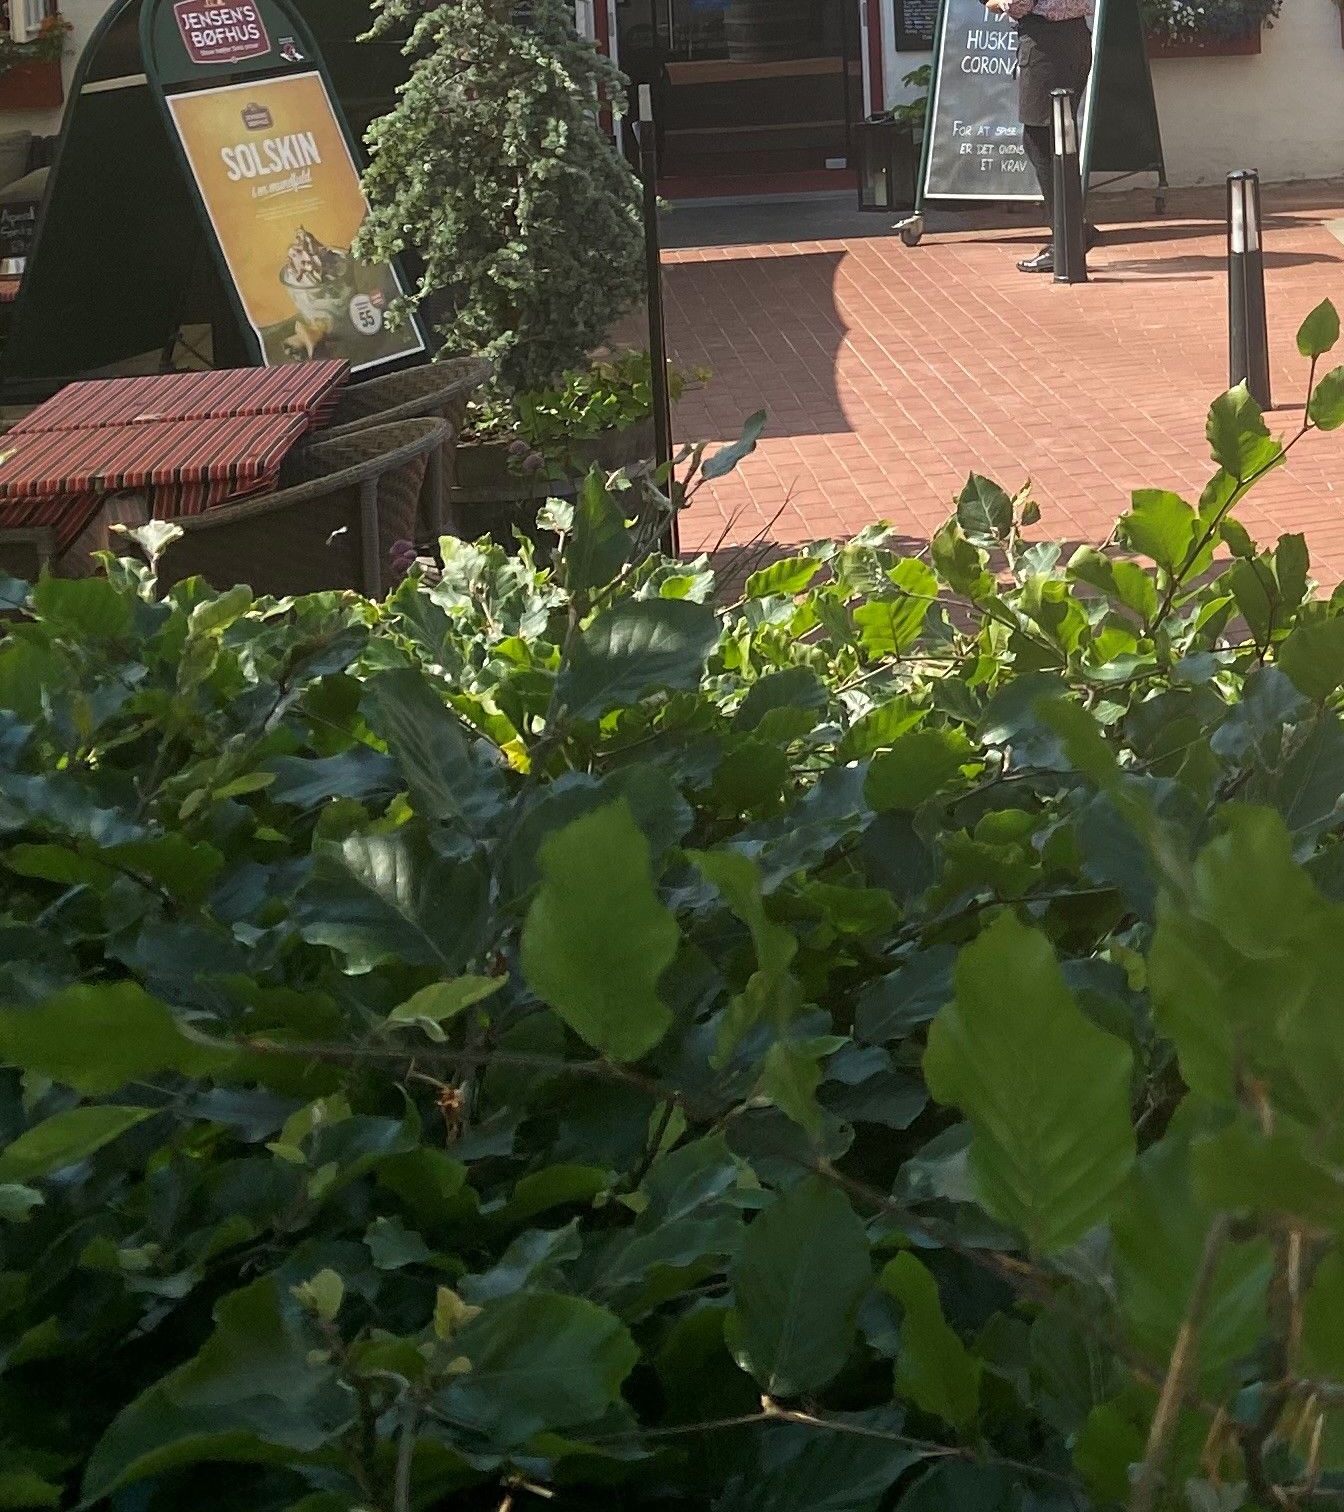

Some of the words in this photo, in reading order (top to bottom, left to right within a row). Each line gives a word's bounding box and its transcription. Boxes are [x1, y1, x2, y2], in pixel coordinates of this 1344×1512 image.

[181, 5, 256, 30] JENSEN'S
[190, 23, 260, 48] BØFHUS
[966, 29, 1018, 51] HUSKE
[976, 125, 991, 137] AT
[221, 131, 322, 181] SOLSKIN
[959, 142, 973, 155] ER
[980, 158, 994, 171] ET
[1000, 159, 1028, 173] KRAV
